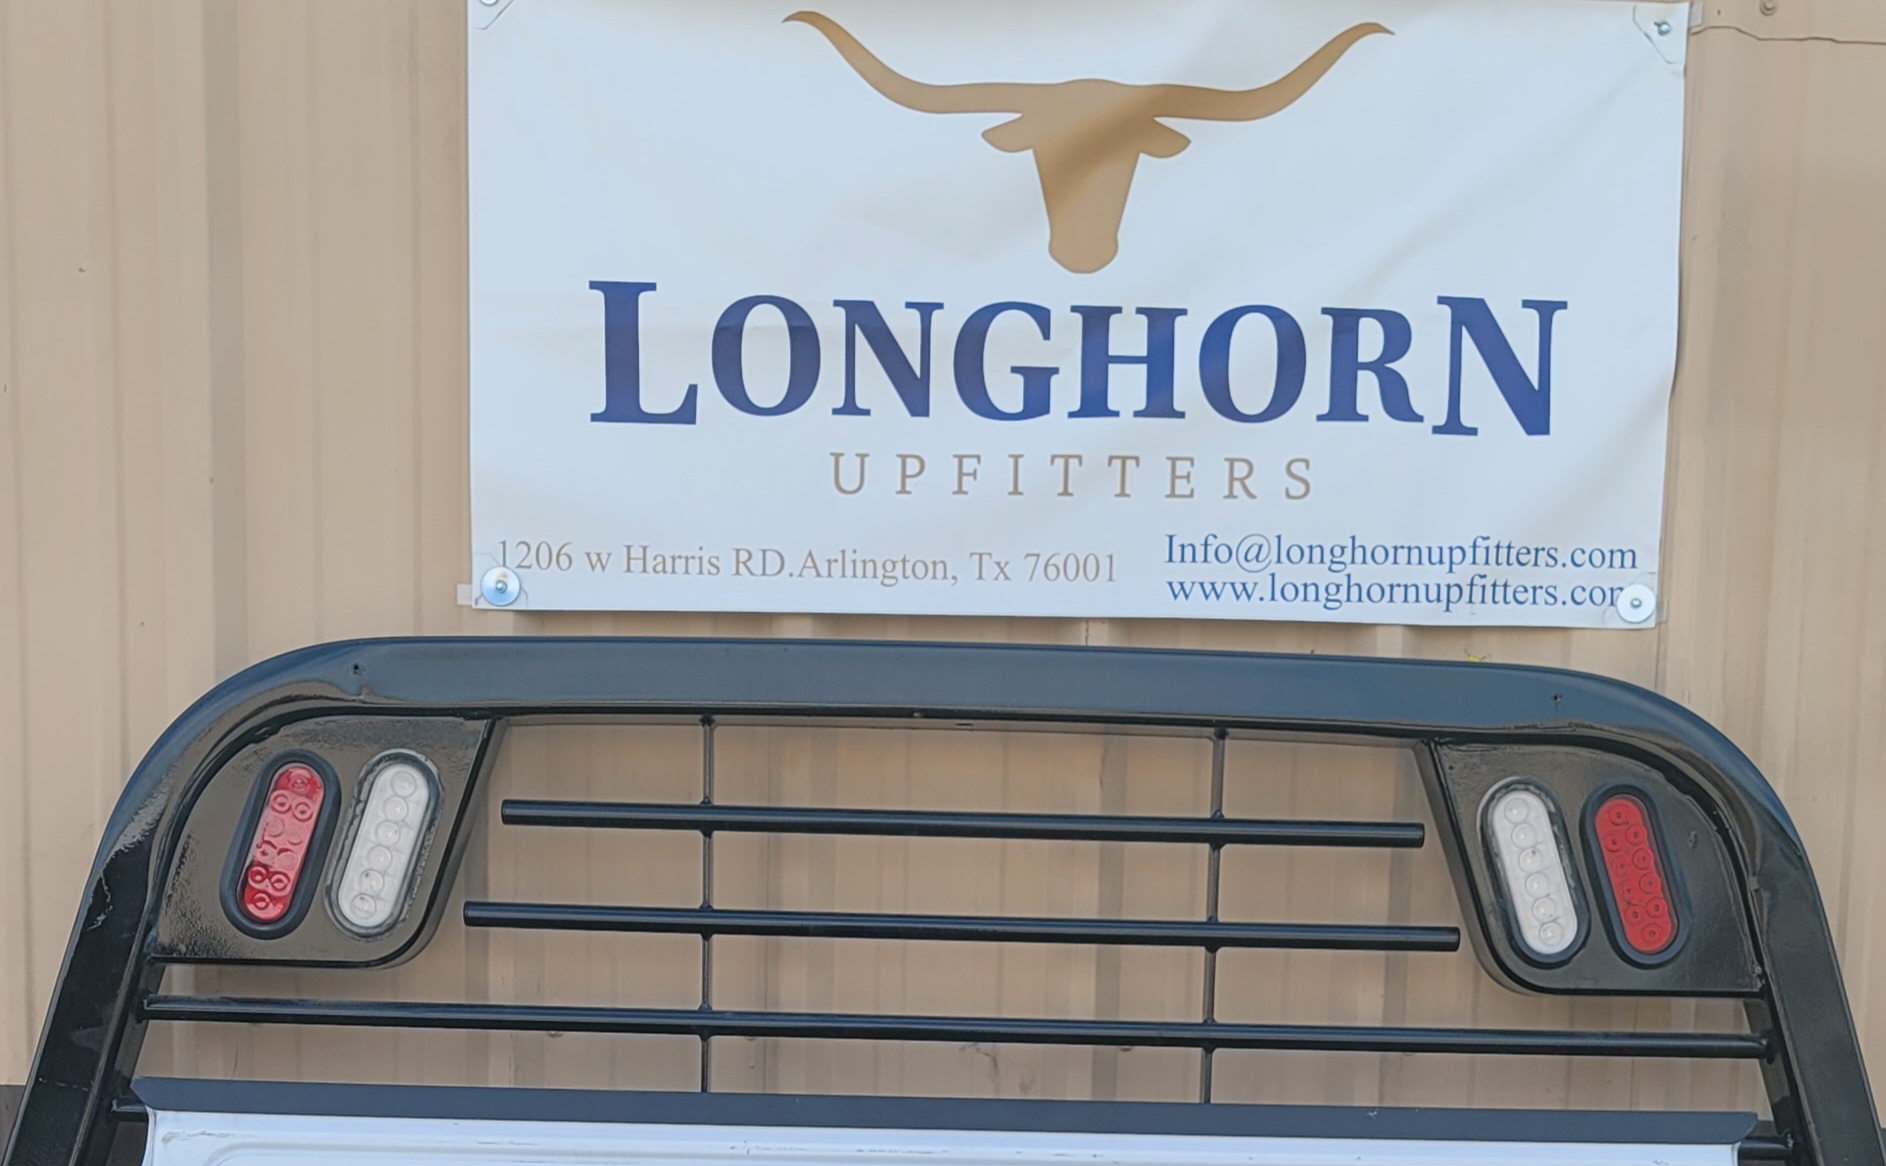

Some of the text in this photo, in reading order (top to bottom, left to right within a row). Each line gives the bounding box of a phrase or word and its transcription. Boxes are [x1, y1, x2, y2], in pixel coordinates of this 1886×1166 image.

[589, 280, 1568, 436] LONGHORN
[829, 452, 1311, 500] UPFITTERS
[498, 540, 573, 572] 1206
[584, 551, 612, 573] w
[622, 544, 720, 577] Harris
[969, 552, 1012, 581] Tx
[1023, 552, 1116, 583] 76001
[1164, 534, 1638, 573] Info@longhornupfitters.com
